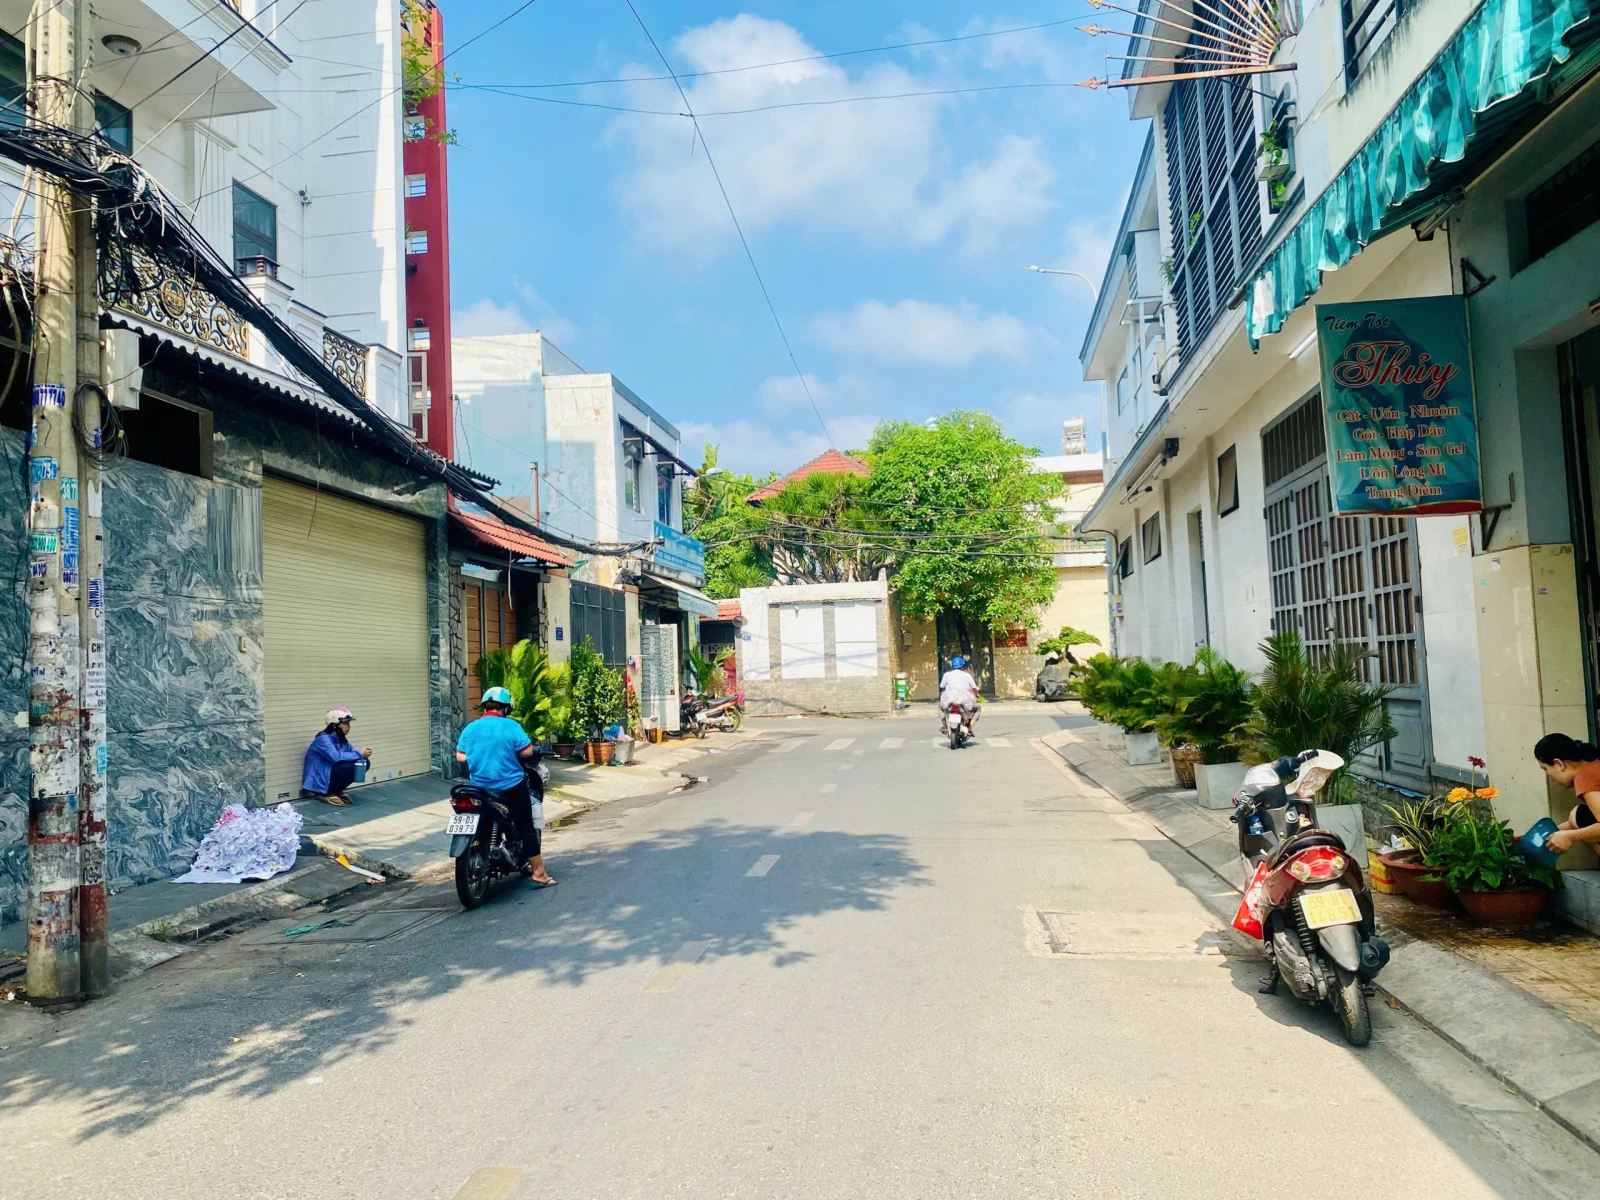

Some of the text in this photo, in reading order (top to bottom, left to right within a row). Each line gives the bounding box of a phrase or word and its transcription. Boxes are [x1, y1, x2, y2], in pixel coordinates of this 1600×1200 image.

[1324, 312, 1390, 334] Tiệm Tóc
[1333, 341, 1460, 400] Thủy
[1371, 406, 1400, 420] Uốn
[1410, 404, 1459, 419] Nhuộm
[1353, 427, 1376, 442] Gội
[1387, 424, 1415, 440] Hấp
[1418, 422, 1445, 437] Dầu
[1336, 450, 1366, 462] Làm
[1369, 447, 1406, 461] Móng
[1416, 444, 1440, 457] Sơn
[1444, 442, 1466, 454] Gel
[1360, 463, 1445, 480] Uốn Lông Mi
[1365, 485, 1404, 499] Trang
